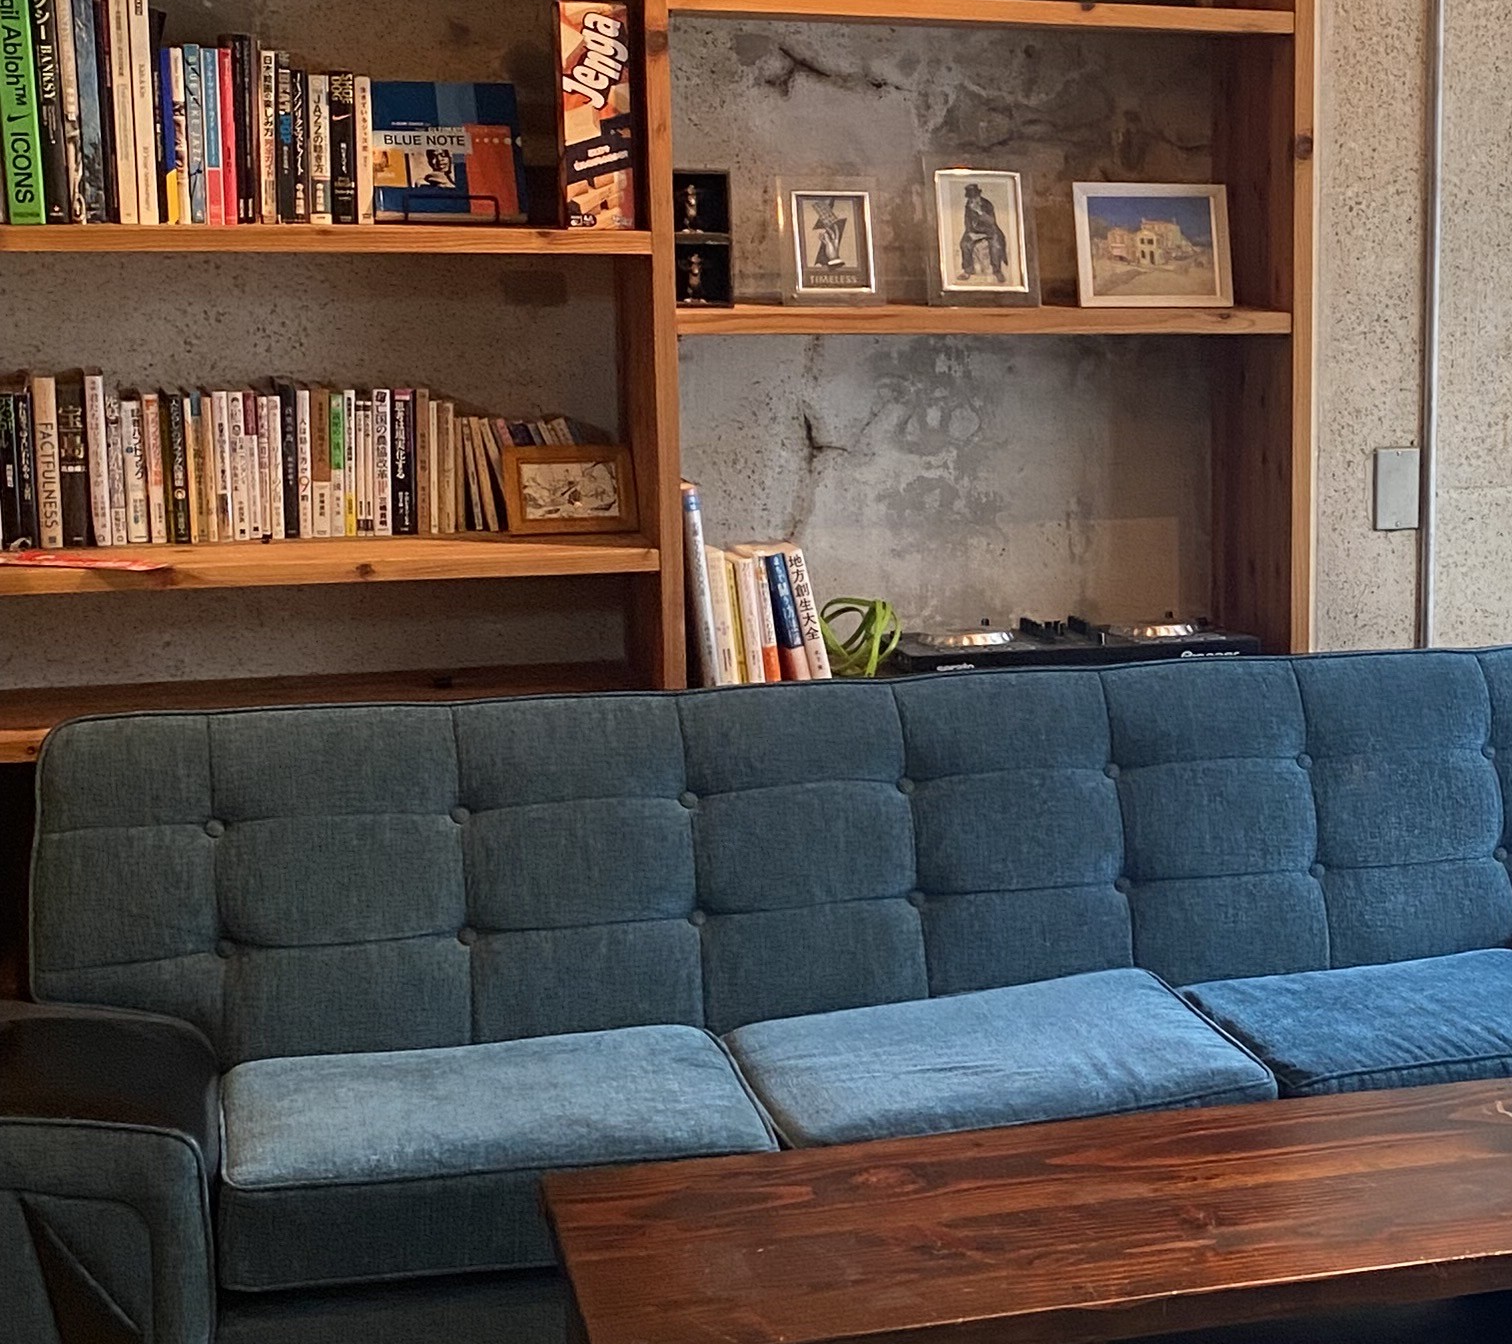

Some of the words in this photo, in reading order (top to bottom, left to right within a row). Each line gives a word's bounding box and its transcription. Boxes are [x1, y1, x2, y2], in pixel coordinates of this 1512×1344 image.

[40, 44, 57, 102] BANKSY
[331, 76, 340, 102] DOG
[341, 73, 353, 104] SHOE
[562, 11, 630, 110] Jenga
[11, 132, 35, 203] ICONS
[383, 134, 422, 145] BLUE
[426, 135, 465, 146] NOTE
[809, 275, 858, 284] TIMELESS
[394, 401, 406, 479] 思考は現実化する
[37, 422, 58, 529] FACTFULNESS
[789, 554, 820, 642] 地方創生大全
